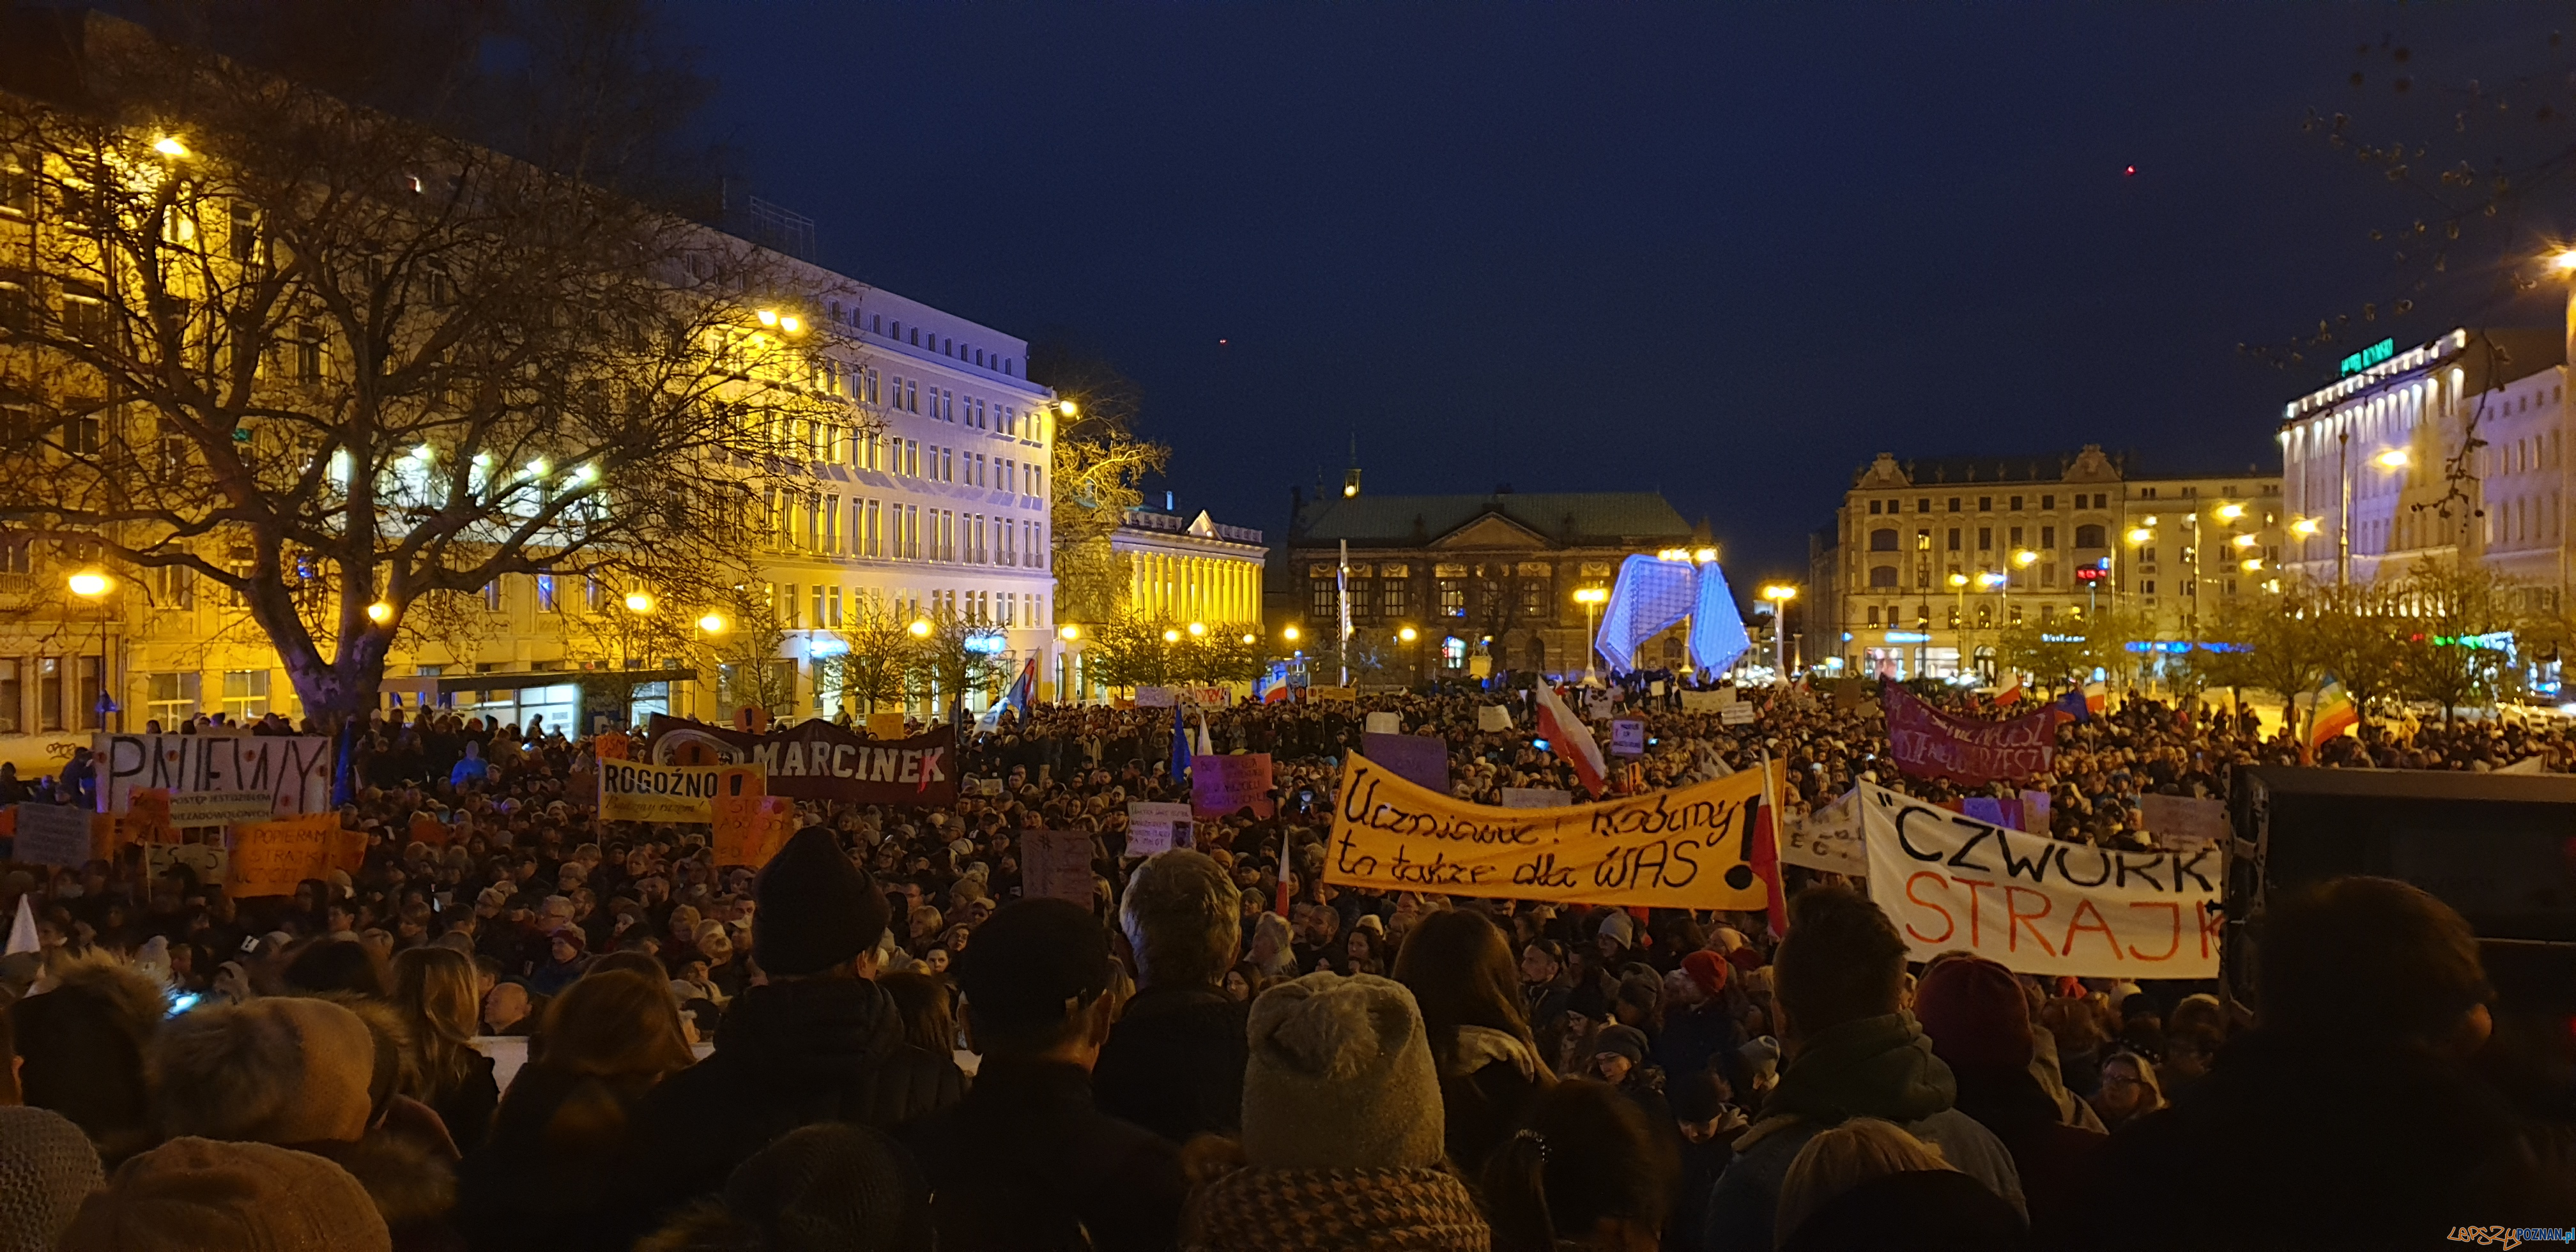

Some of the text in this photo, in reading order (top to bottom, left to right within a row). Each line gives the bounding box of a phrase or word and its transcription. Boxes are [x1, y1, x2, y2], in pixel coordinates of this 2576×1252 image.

[109, 736, 327, 814] PNIEWY
[604, 764, 718, 799] ROGOŹNO
[753, 740, 946, 784] MARCINEK
[253, 829, 326, 844] POPIERAM
[1513, 852, 1576, 887] dla
[1593, 839, 1699, 890] WAS
